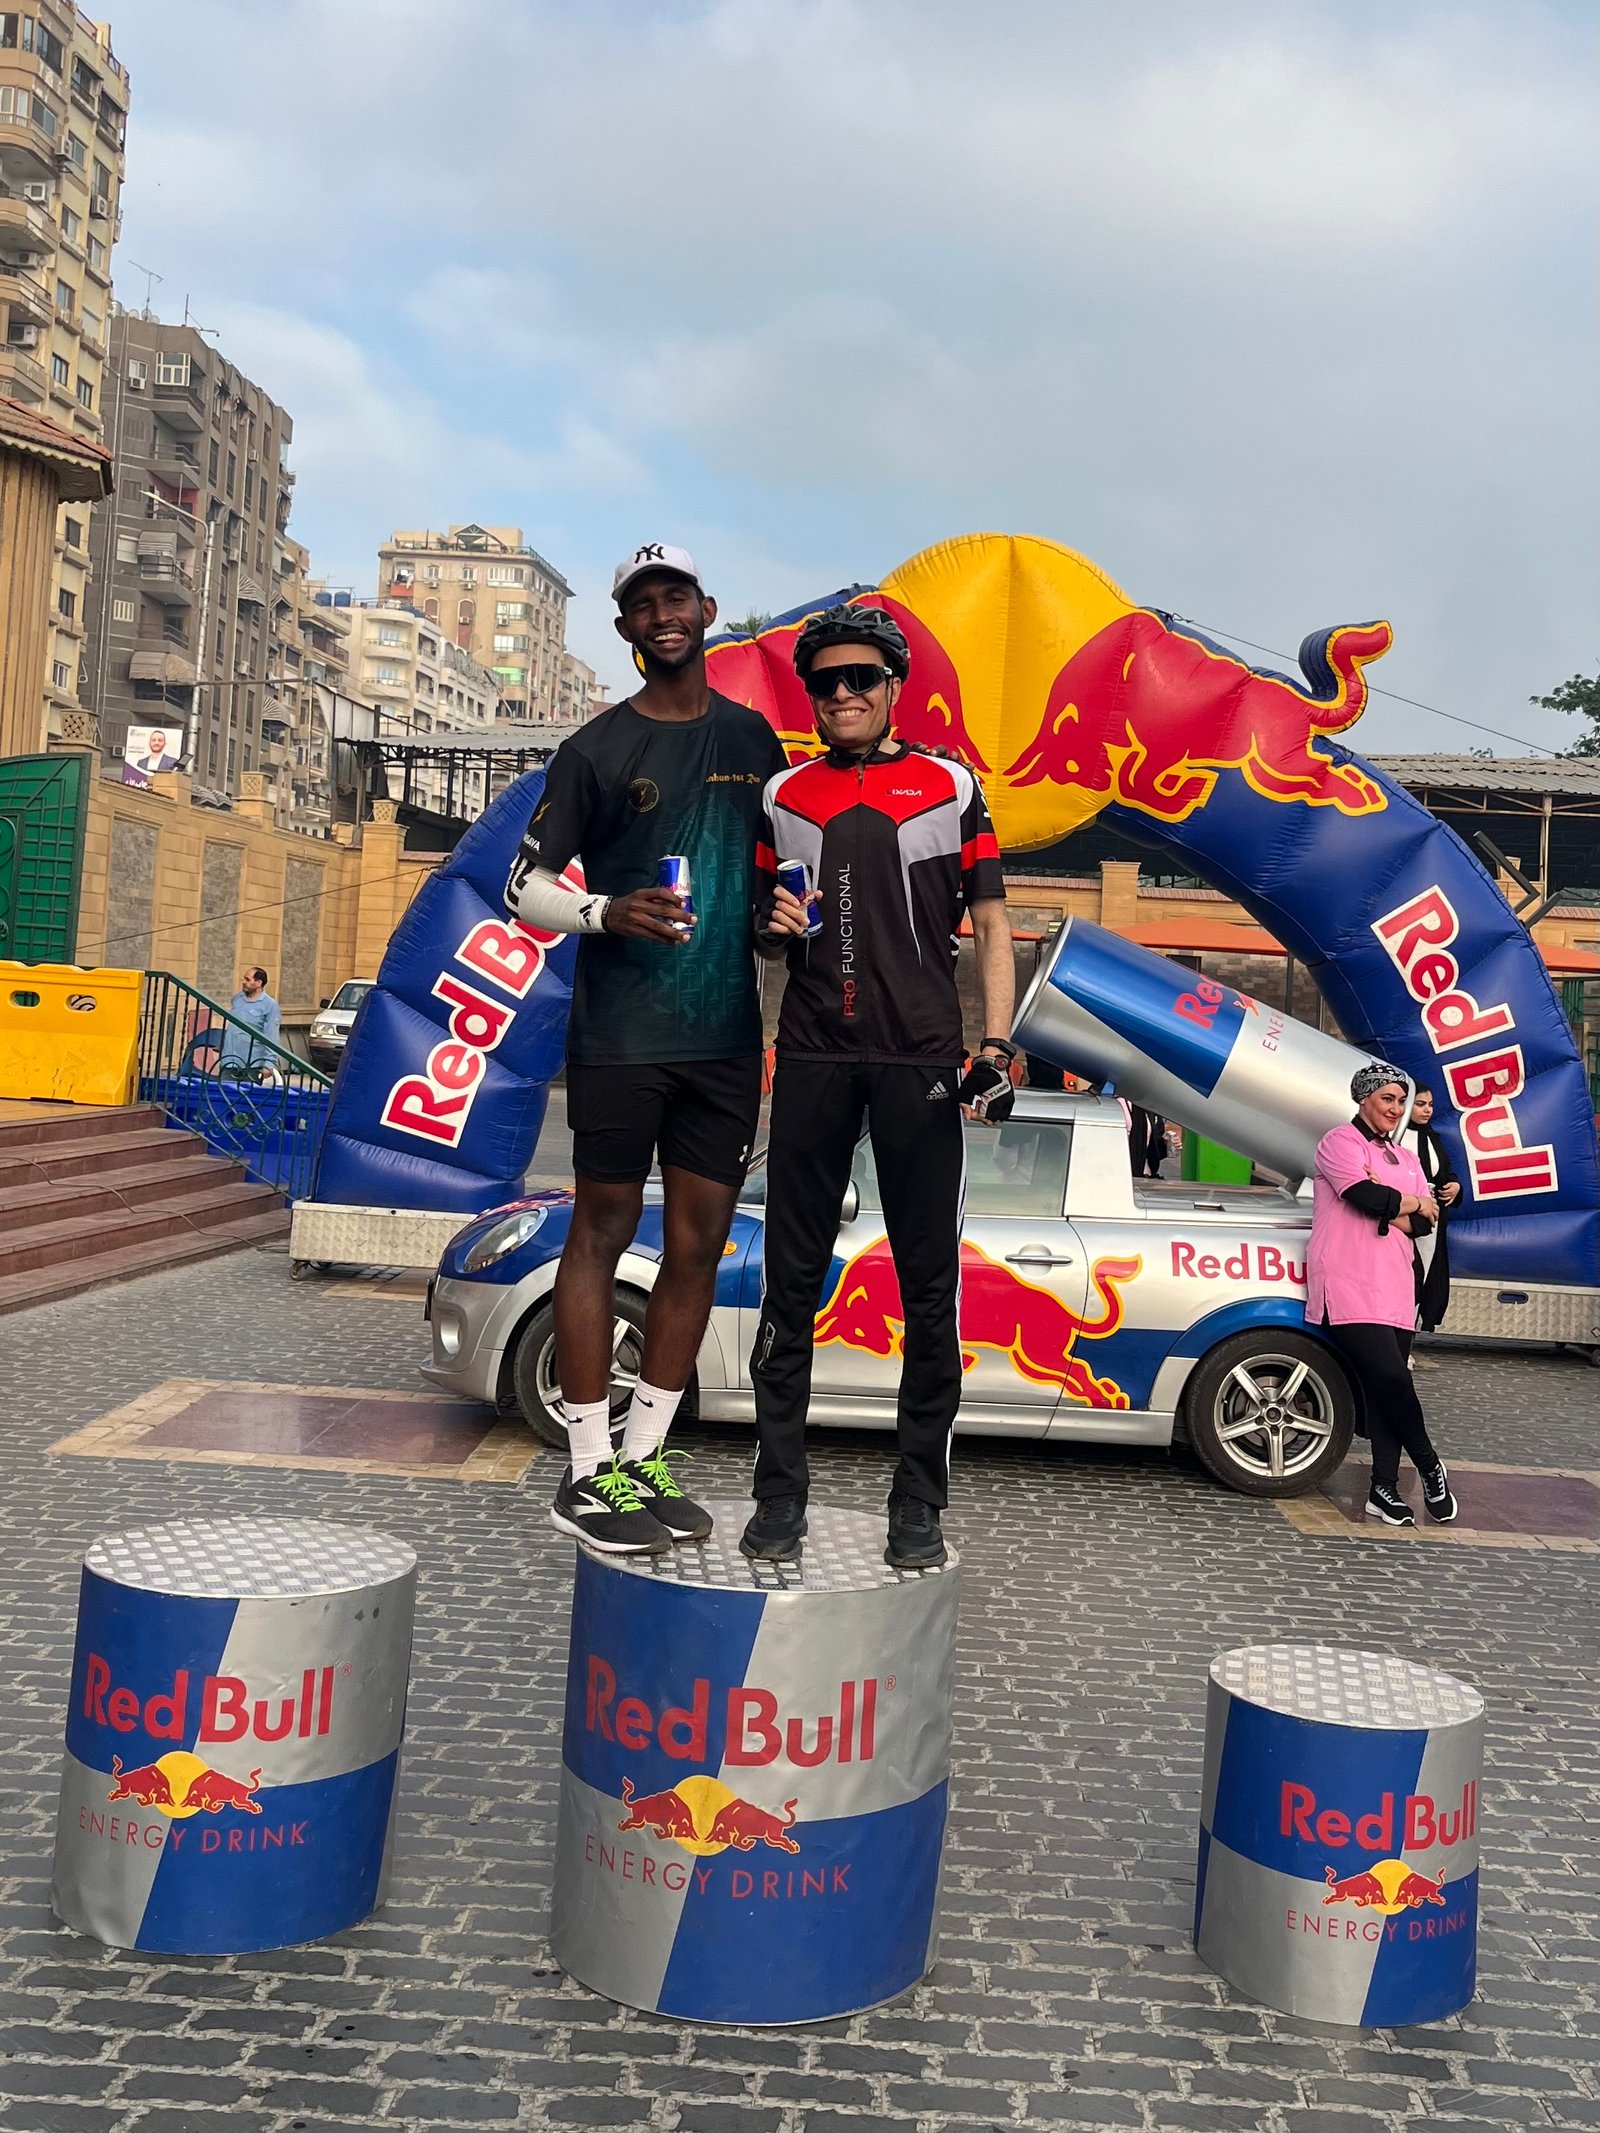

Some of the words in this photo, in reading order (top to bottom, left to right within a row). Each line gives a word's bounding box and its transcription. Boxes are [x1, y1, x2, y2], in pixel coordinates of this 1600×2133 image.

[839, 863, 854, 973] FUNCTIONAL
[843, 979, 856, 1016] PRO
[384, 975, 513, 1145] Red
[1375, 889, 1512, 1050] Red
[1447, 1048, 1554, 1198] Bull
[1171, 1241, 1250, 1280] Red
[1257, 1246, 1307, 1284] Bu
[83, 1653, 189, 1740] Red
[199, 1666, 334, 1743] Bull
[586, 1654, 710, 1762] Red
[725, 1678, 876, 1767] Bull
[80, 1806, 188, 1853] ENERGY
[201, 1822, 310, 1853] DRINK
[1280, 1780, 1393, 1851] Red
[1404, 1778, 1478, 1851] Bull
[585, 1835, 713, 1895] ENERGY
[732, 1864, 852, 1899] DRINK
[1286, 1909, 1400, 1942] ENERGY
[1409, 1910, 1467, 1941] DRINK
